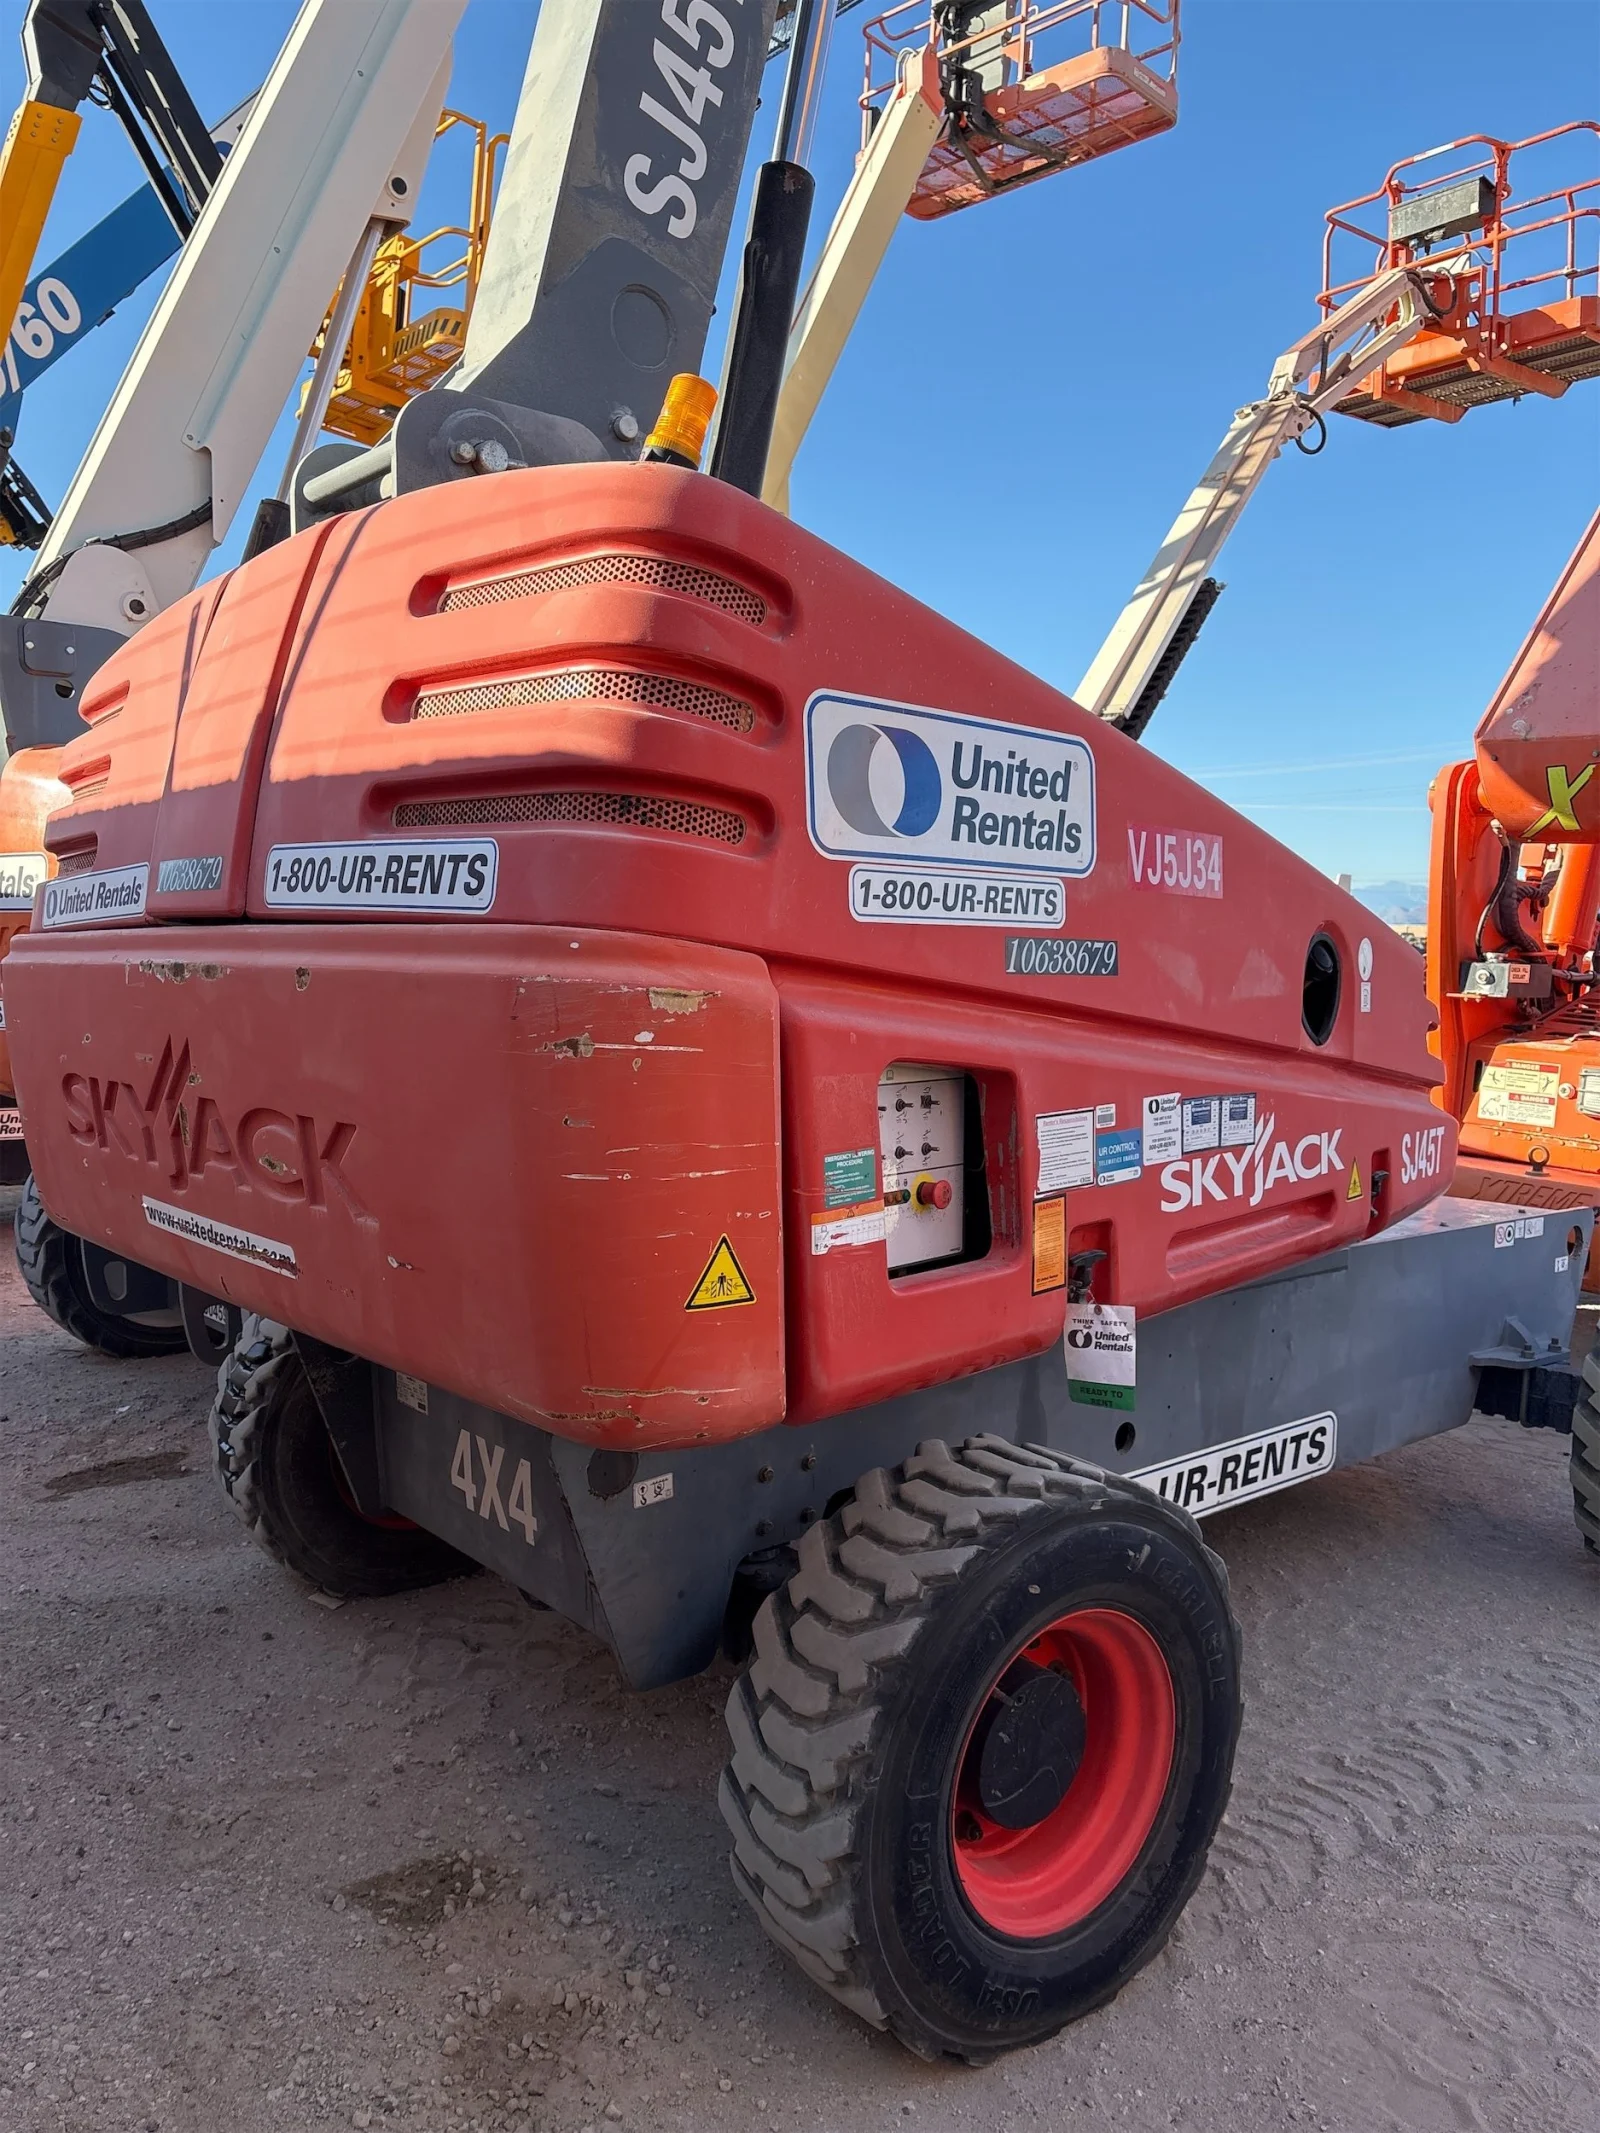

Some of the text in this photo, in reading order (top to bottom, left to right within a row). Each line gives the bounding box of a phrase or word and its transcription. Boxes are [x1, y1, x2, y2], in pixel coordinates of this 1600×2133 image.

[624, 0, 744, 239] SJ45
[951, 741, 1072, 802] United
[950, 795, 1082, 854] Rentals
[0, 866, 34, 898] tals
[155, 854, 224, 893] 10638679
[271, 853, 489, 897] 1-800-UR-RENTS
[1127, 828, 1222, 892] VJ5J34
[58, 876, 142, 916] United Rentals
[859, 878, 1058, 917] 1-800-UR-RENTS
[1005, 938, 1118, 975] 10638679
[60, 1034, 380, 1231] SKYJACK
[1098, 1141, 1136, 1157] UR CONTROL
[1400, 1125, 1446, 1184] SJ45T
[1160, 1111, 1345, 1213] SKYJACK
[1038, 1200, 1062, 1212] WARNING
[1470, 1176, 1594, 1211] XTREME
[146, 1205, 297, 1274] www.unitedrentals.com
[1094, 1331, 1130, 1342] United
[1094, 1341, 1134, 1352] Rentals
[1080, 1386, 1123, 1398] READY TO
[450, 1428, 538, 1547] 4X4
[1159, 1426, 1327, 1508] UR-RENTS
[907, 1822, 971, 1986] LOADER
